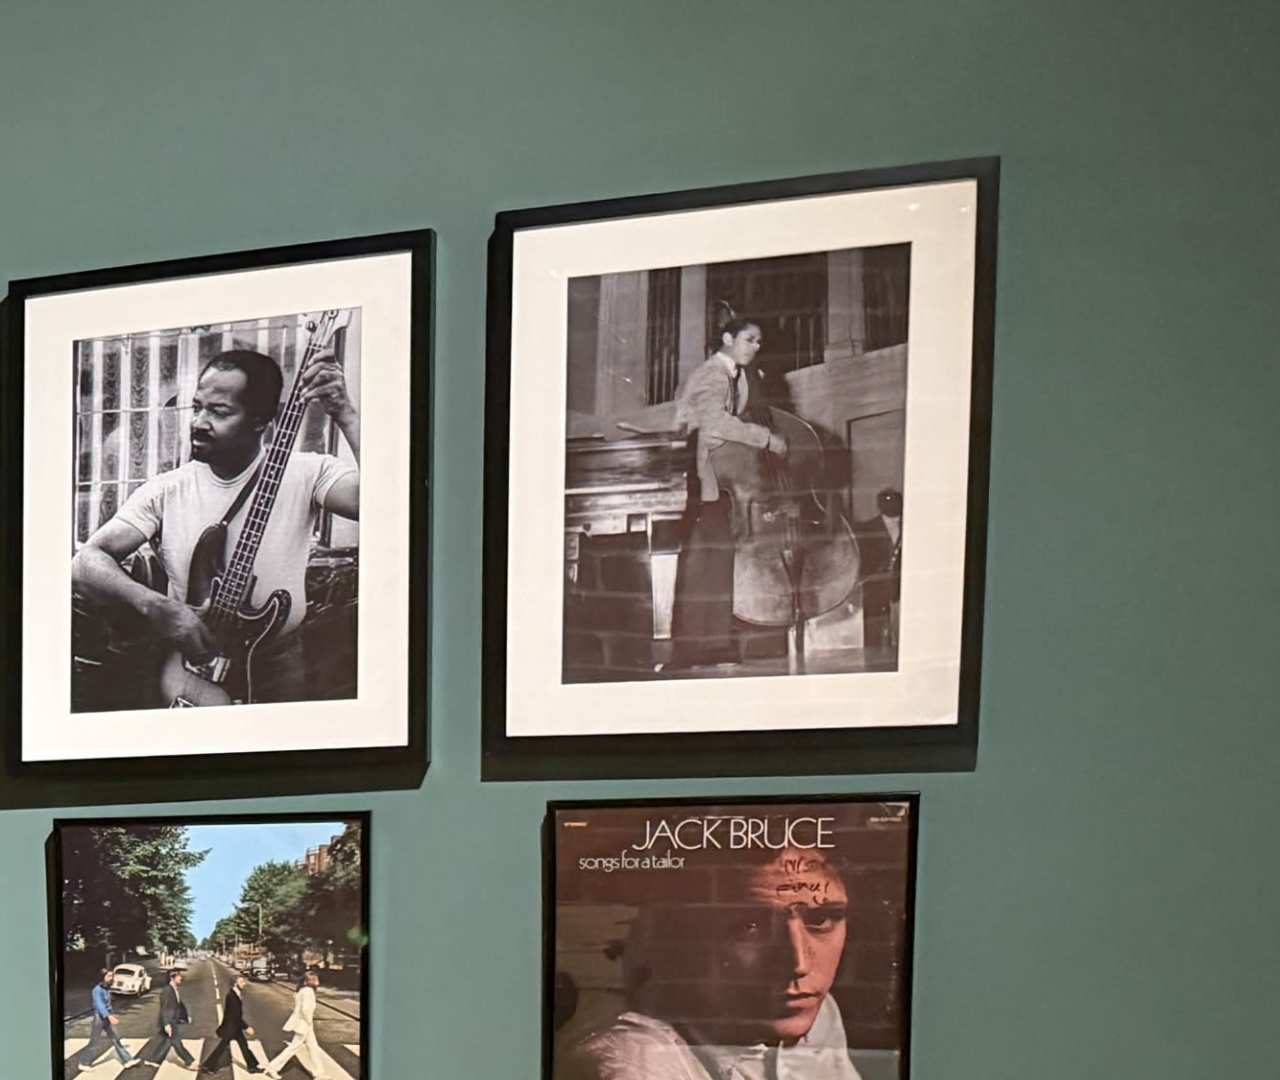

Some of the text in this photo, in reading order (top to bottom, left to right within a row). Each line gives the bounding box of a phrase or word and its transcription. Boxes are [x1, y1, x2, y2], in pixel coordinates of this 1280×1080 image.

[632, 817, 836, 850] JACK BRUCE
[579, 850, 685, 872] songs for a tailor
